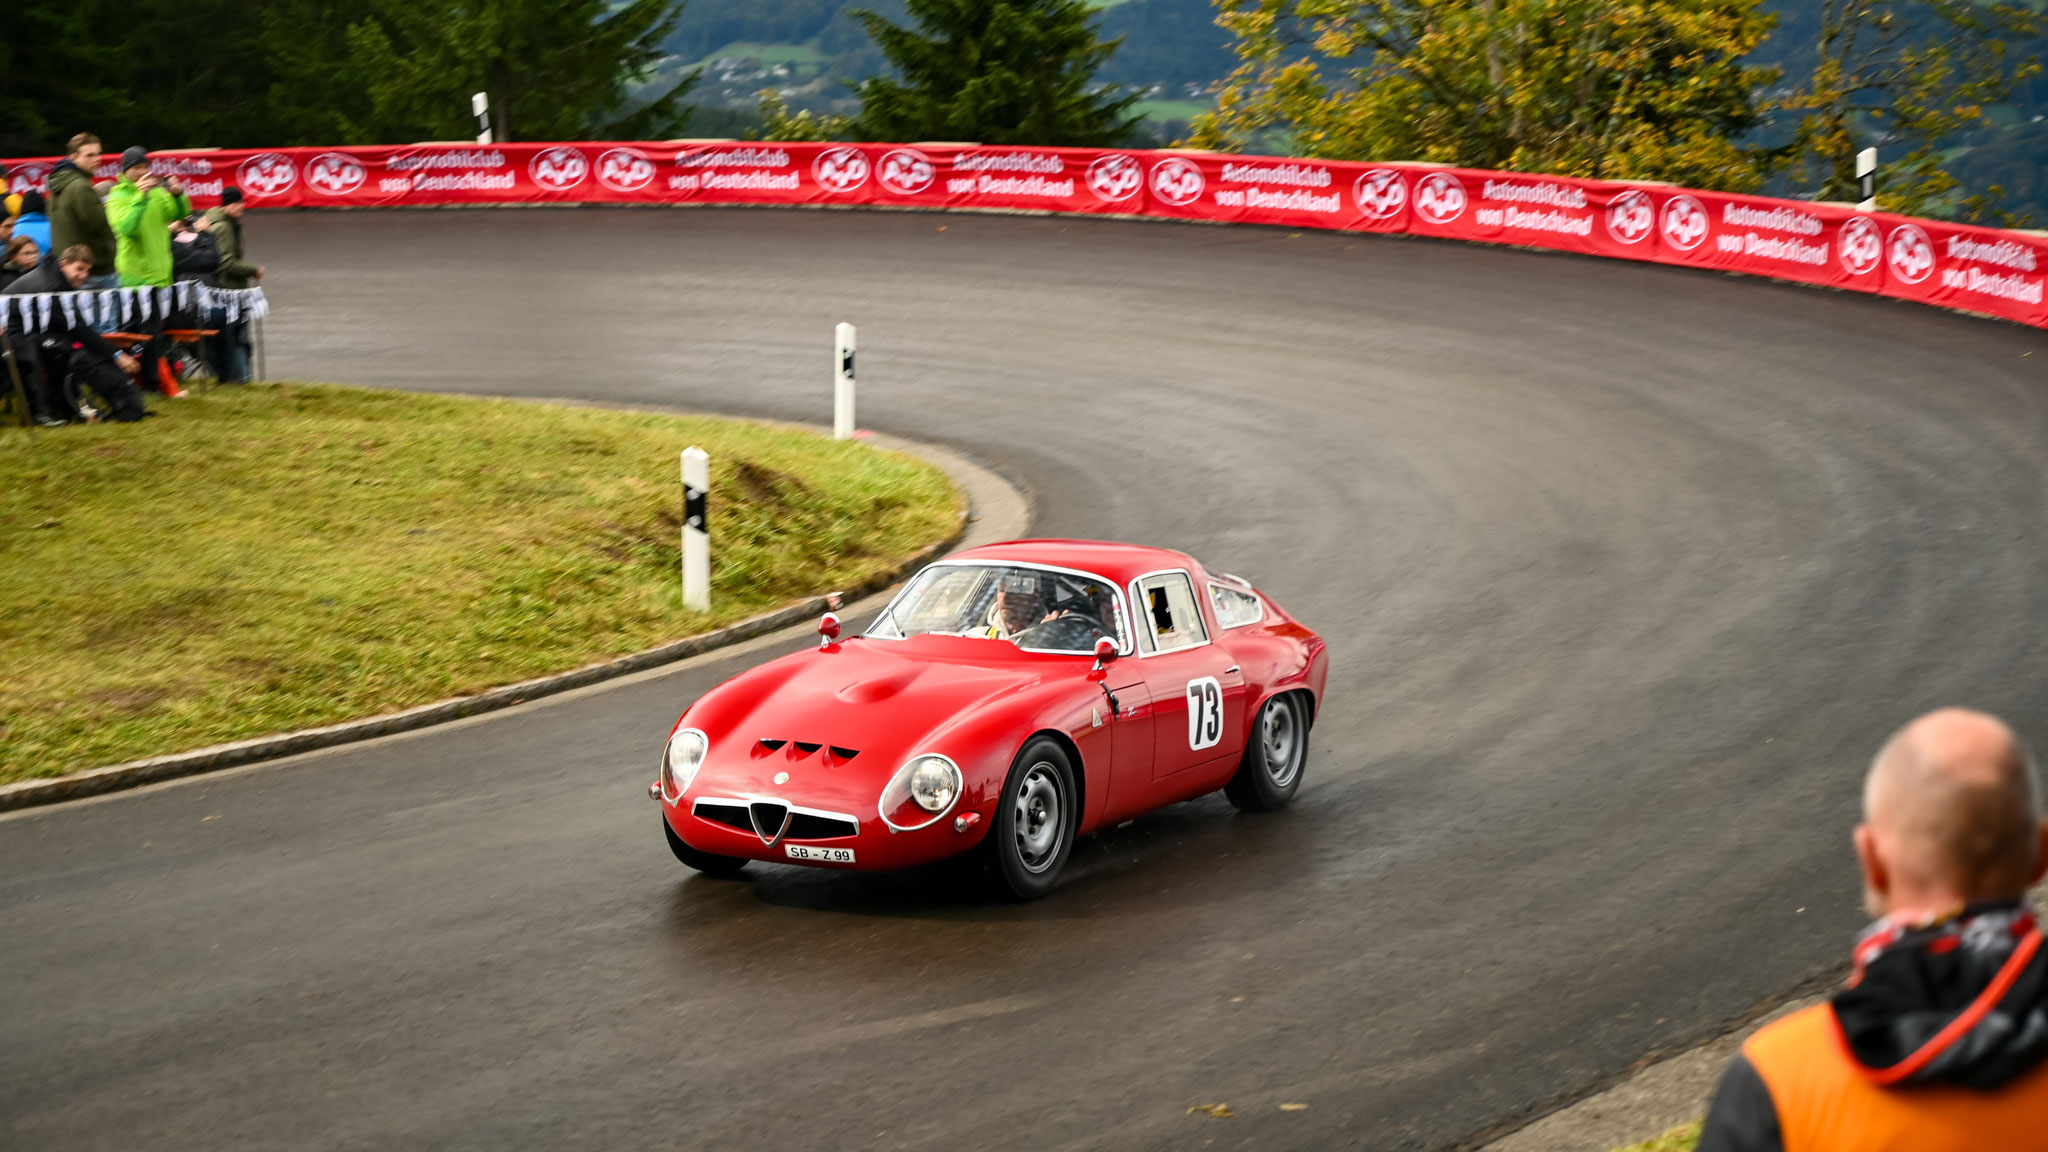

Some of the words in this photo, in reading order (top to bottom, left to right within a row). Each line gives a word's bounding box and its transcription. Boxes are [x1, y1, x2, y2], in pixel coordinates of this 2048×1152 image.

[387, 150, 504, 170] Automobilclub
[674, 148, 789, 168] Automobilclub
[379, 178, 411, 193] von
[413, 171, 515, 190] Deutschland
[669, 175, 699, 189] von
[701, 170, 800, 189] Deutschland
[947, 179, 976, 194] von
[978, 175, 1074, 197] Deutschland
[1221, 163, 1332, 188] Automobilclub
[1215, 191, 1245, 206] von
[1247, 186, 1340, 213] Deutschland
[1482, 179, 1588, 210] Automobilclub
[1476, 209, 1503, 225] von
[1504, 205, 1593, 236] Deutschland
[1723, 202, 1824, 236] Automobilclub
[1717, 235, 1744, 252] von
[1744, 230, 1828, 265] Deutschland
[1942, 269, 1968, 289] von
[1968, 266, 2044, 305] Deutschland
[1190, 682, 1219, 745] 73
[790, 847, 809, 858] SB
[822, 850, 831, 860] Z
[834, 850, 850, 861] 99
